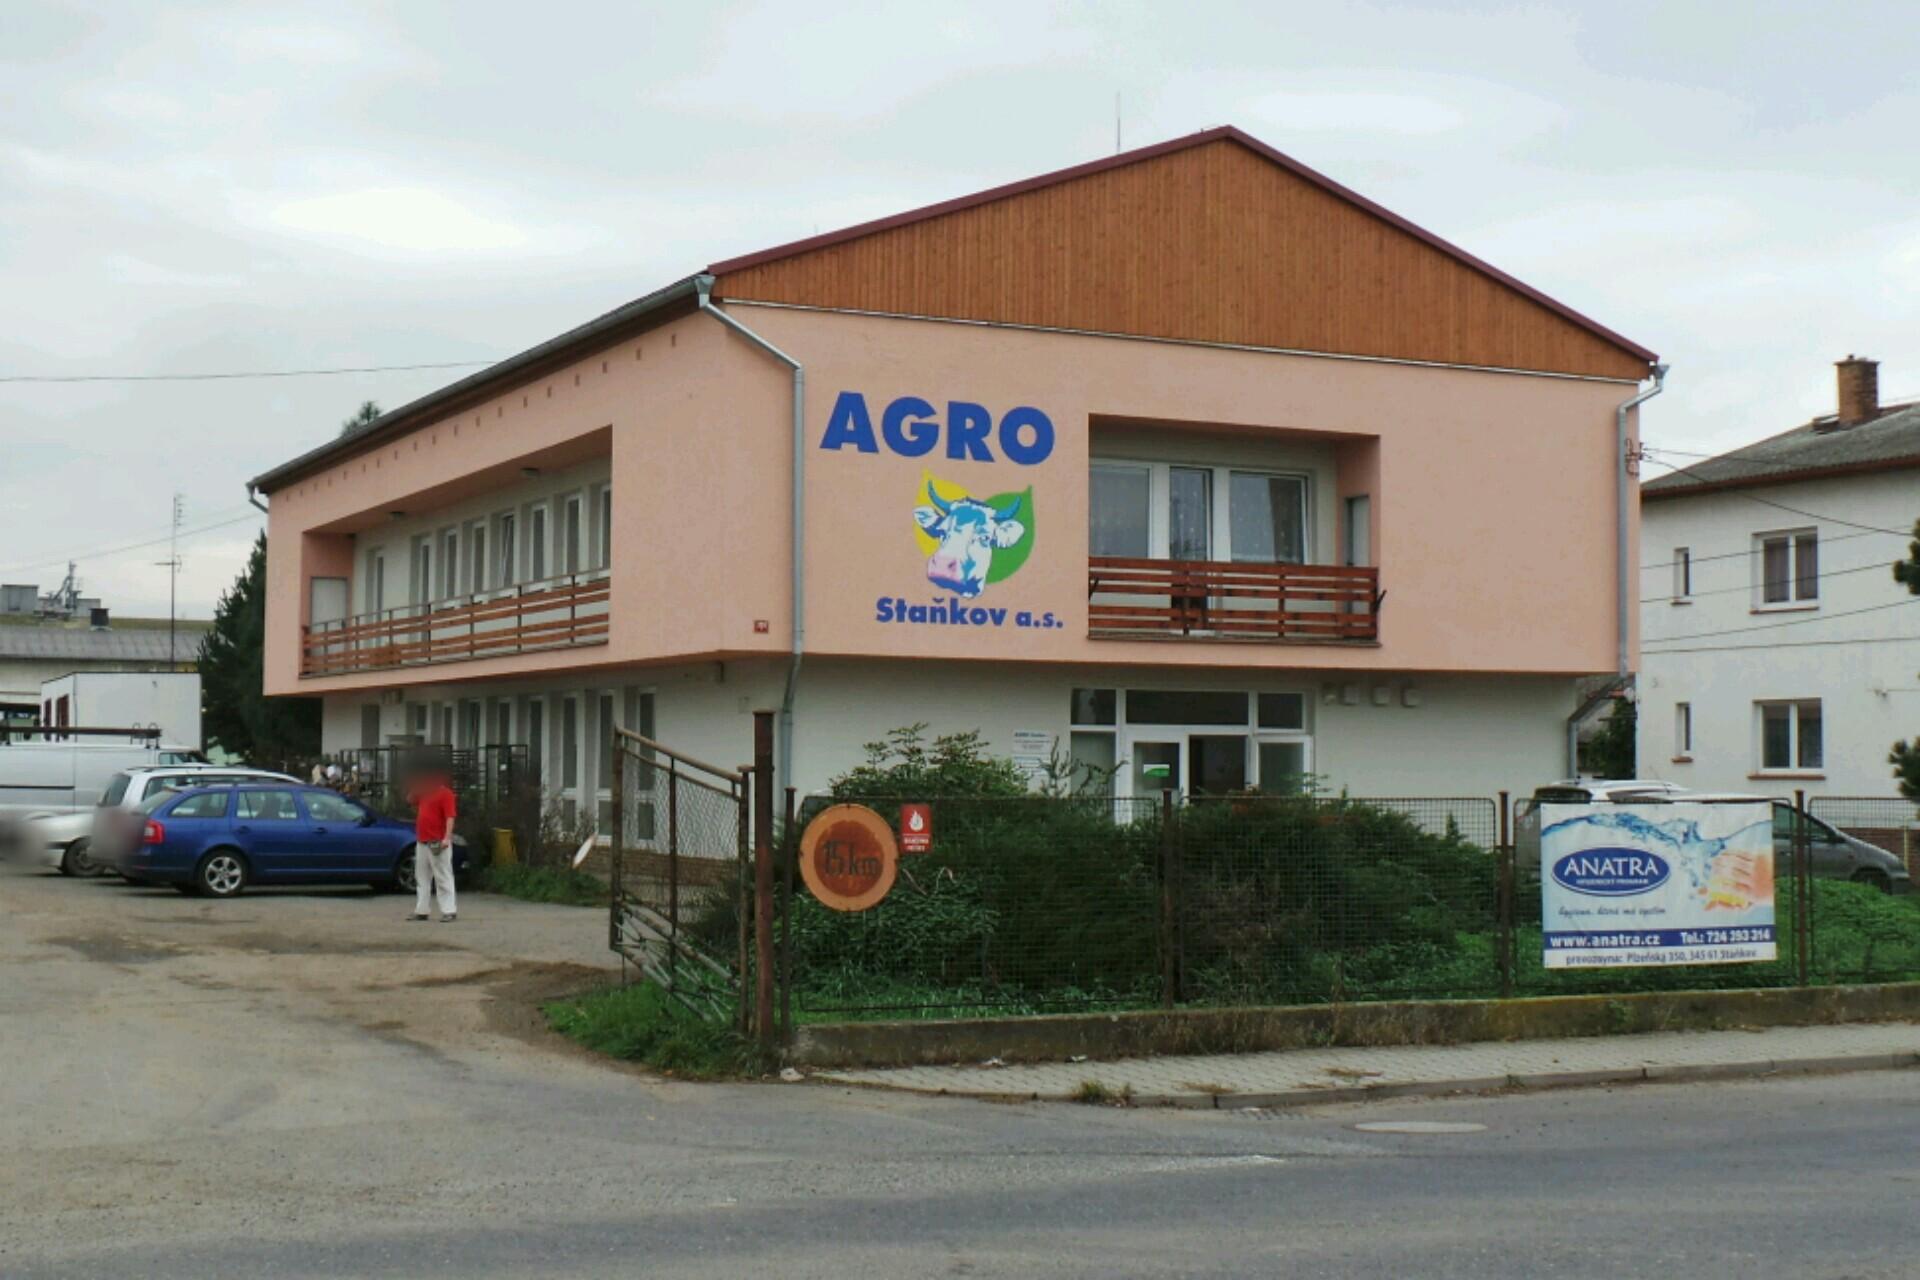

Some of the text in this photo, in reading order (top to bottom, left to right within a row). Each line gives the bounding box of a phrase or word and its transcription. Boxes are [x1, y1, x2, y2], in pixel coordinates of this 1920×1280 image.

[820, 391, 1055, 466] AGRO
[876, 597, 1063, 629] Staňkov a.s.
[1563, 857, 1659, 876] ANATRA
[1550, 933, 1661, 948] www.anatra.cz
